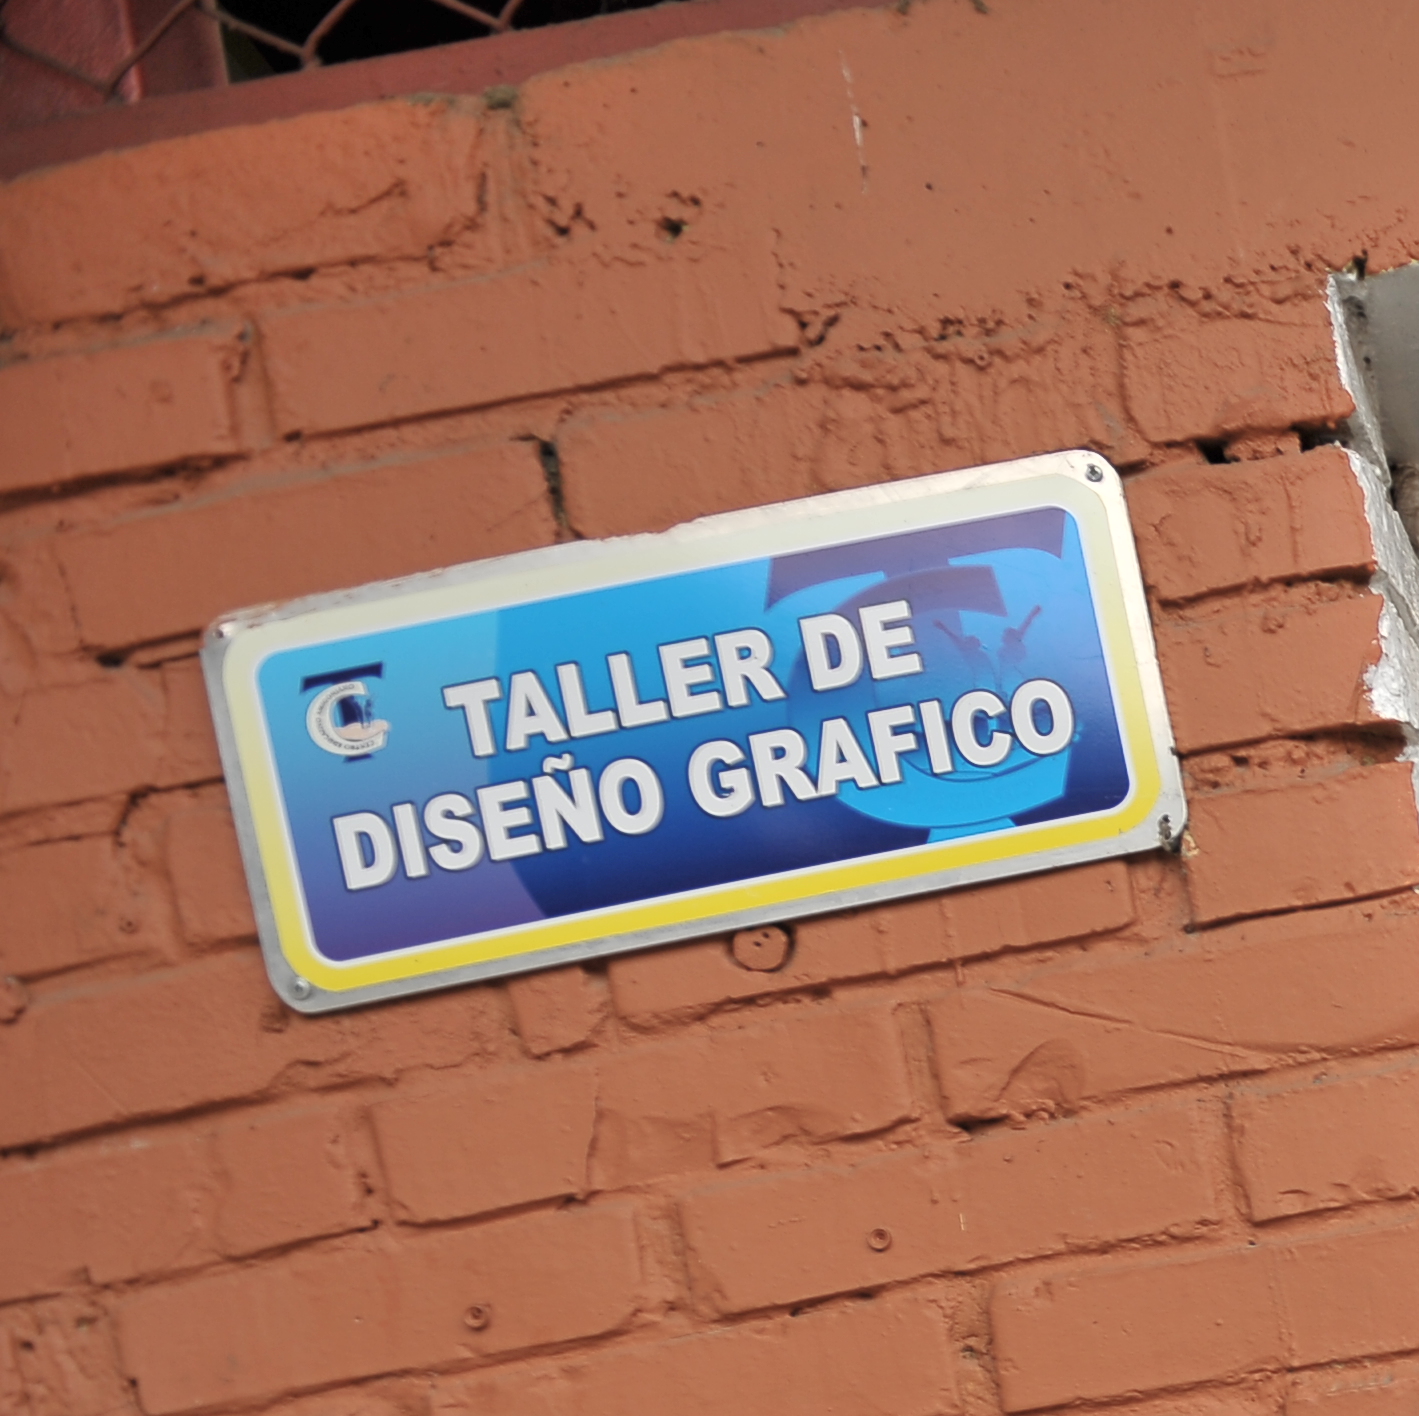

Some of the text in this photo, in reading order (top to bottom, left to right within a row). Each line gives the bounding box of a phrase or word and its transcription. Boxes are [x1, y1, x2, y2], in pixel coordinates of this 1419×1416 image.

[442, 599, 924, 758] TALLER DE
[332, 677, 1076, 892] DISEÑO GRAFICO
